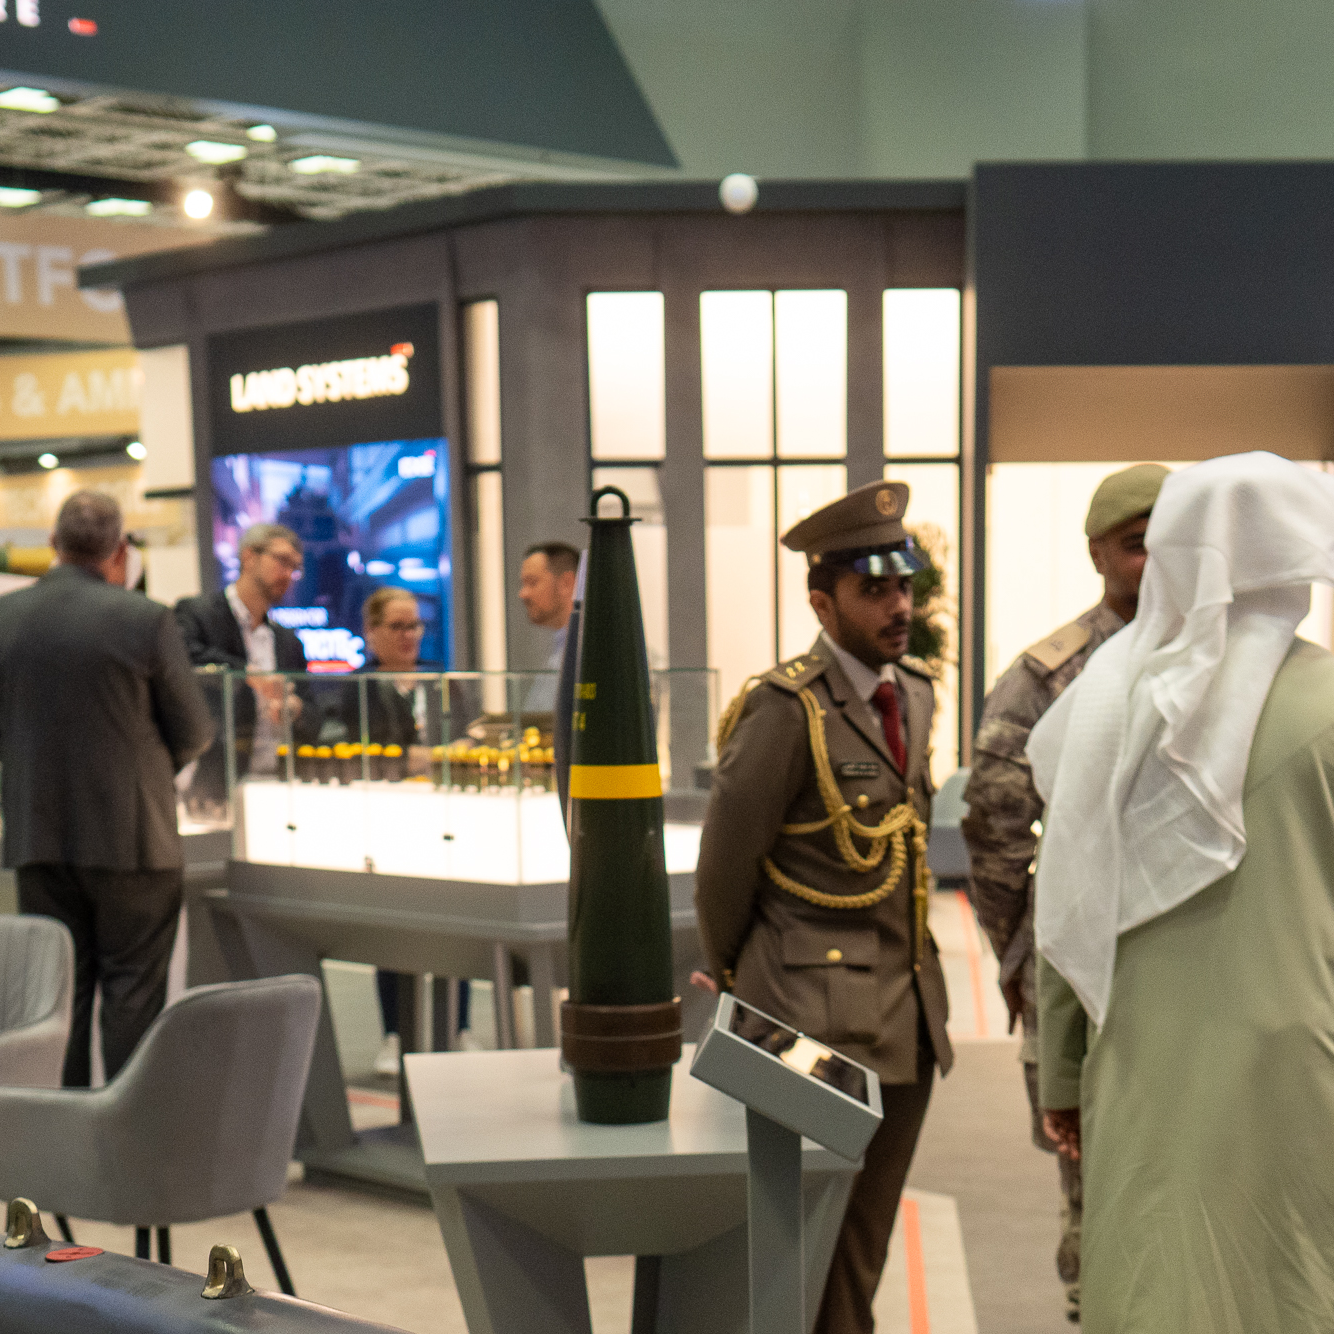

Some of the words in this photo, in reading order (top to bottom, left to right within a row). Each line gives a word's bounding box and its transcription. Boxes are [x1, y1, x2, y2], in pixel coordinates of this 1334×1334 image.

[11, 372, 46, 418] &
[230, 367, 296, 413] LAND
[295, 354, 410, 406] SYSTEMS
